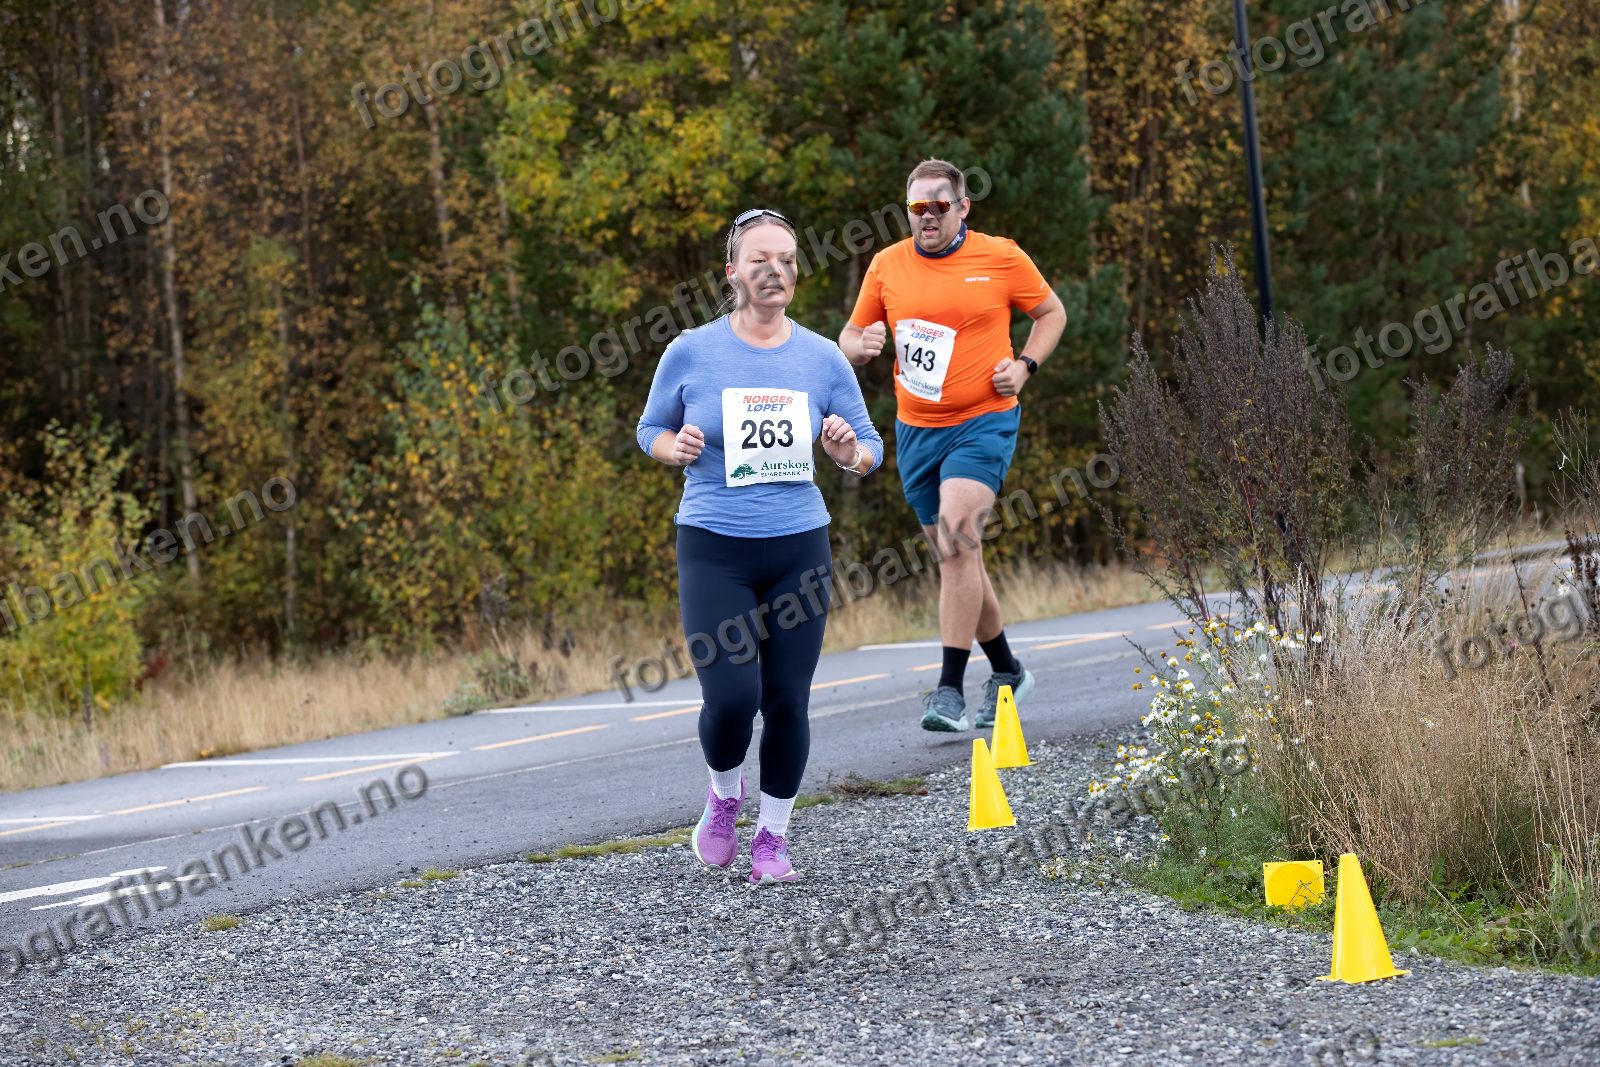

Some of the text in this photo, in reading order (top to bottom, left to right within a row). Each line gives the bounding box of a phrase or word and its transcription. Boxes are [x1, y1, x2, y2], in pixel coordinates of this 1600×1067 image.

[904, 343, 936, 371] 143
[742, 395, 793, 404] NORGES
[747, 403, 786, 412] LØPET
[741, 419, 794, 450] 263
[761, 460, 810, 472] Aurskog
